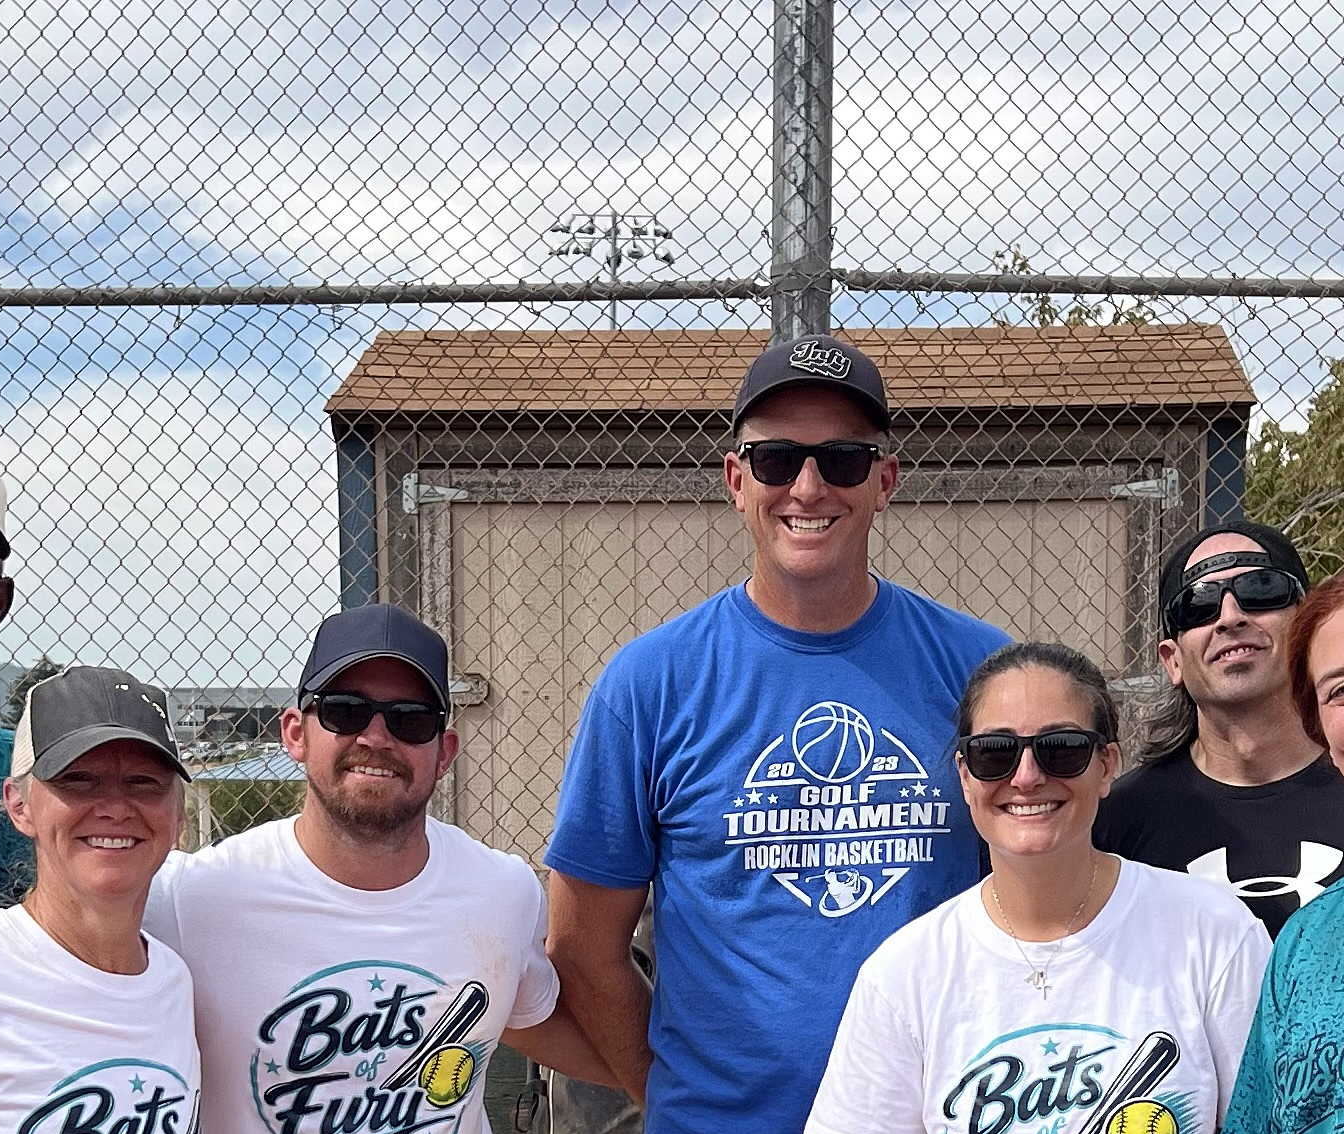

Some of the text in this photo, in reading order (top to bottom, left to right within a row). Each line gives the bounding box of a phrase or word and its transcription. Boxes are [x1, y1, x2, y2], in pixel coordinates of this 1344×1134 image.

[766, 756, 899, 779] 20 23
[799, 782, 877, 806] GOLF
[723, 802, 951, 837] TOURNAMENT
[744, 837, 934, 870] ROCKLIN BASKETBALL
[258, 984, 438, 1073] Bats
[355, 1052, 387, 1081] of
